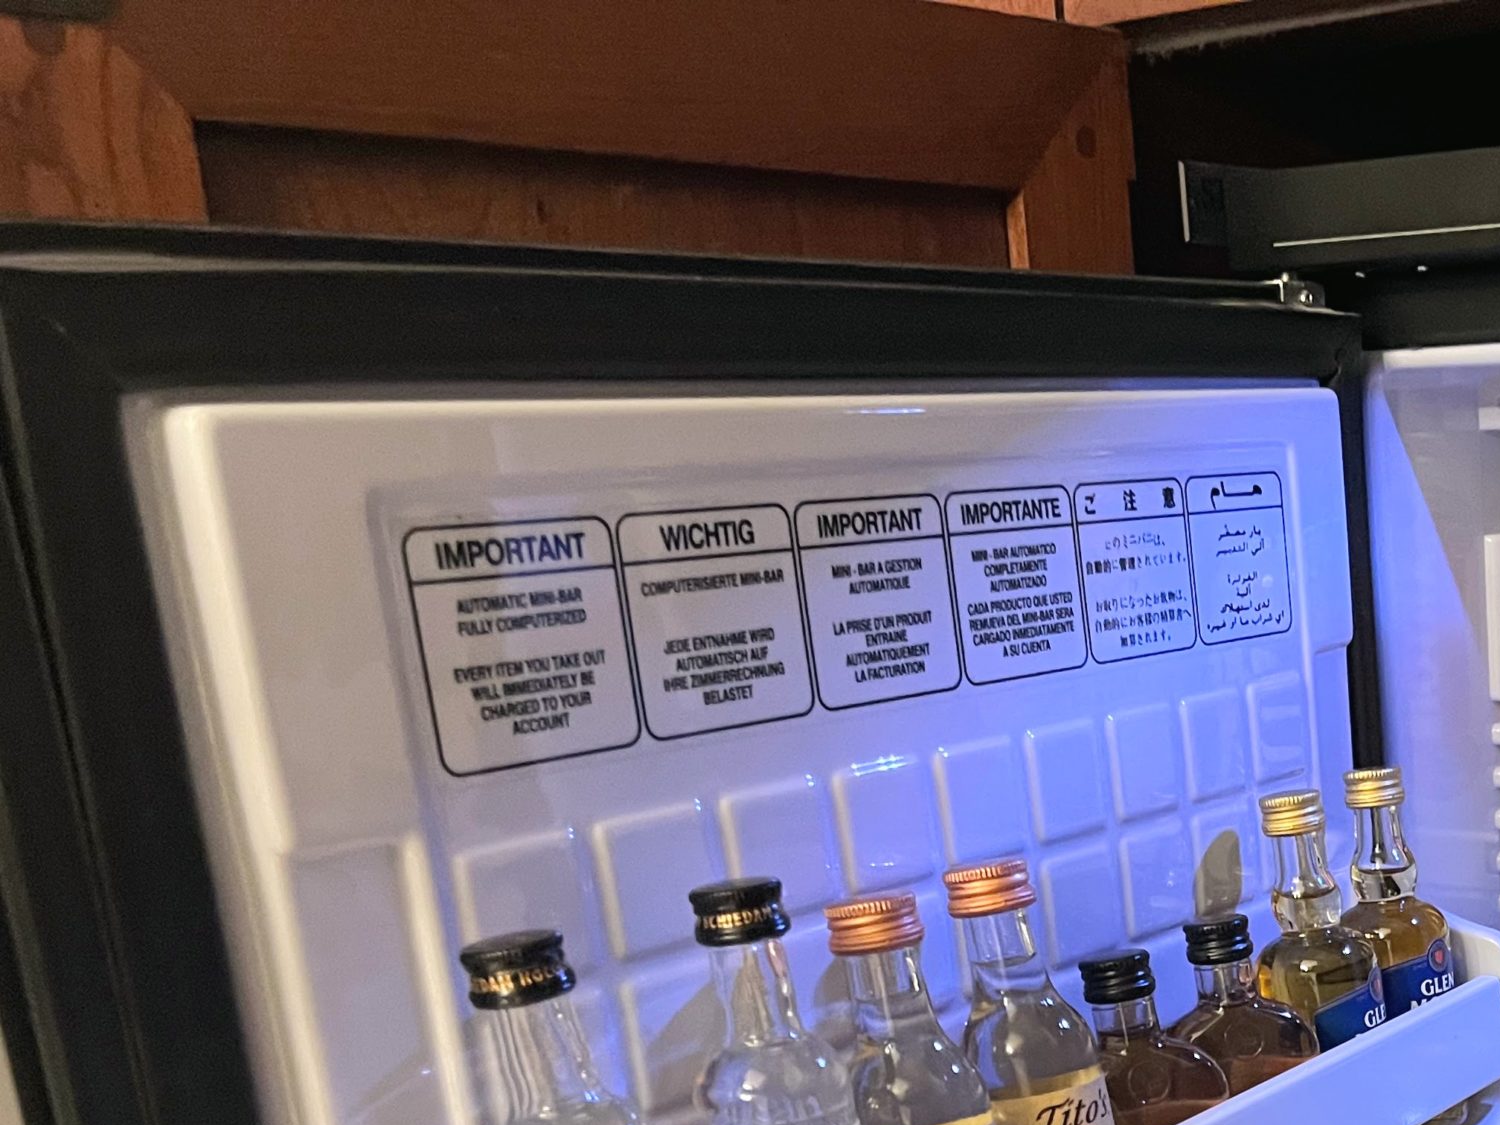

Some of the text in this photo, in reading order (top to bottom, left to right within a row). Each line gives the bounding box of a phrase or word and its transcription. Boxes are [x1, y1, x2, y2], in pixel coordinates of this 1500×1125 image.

[816, 507, 922, 539] IMPORTANT
[960, 498, 1062, 526] IMPORTANTE
[659, 519, 756, 552] WICHTIG
[434, 533, 586, 570] IMPORTANT
[1010, 542, 1057, 558] AUTOMATICO
[885, 557, 923, 574] GESTION
[983, 558, 1048, 578] COMPLETAMENTE
[640, 568, 785, 597] COMPUTERISIERTE MINI-BAR
[849, 576, 911, 595] AUTOMATIQUE
[990, 574, 1047, 593] AUTOMATIZADO
[457, 587, 583, 614] AUTOMATIC MINI-BAR
[967, 591, 1073, 617] CADA PRODUCTO QUE USTED
[457, 608, 587, 637] FULLY COMPUTERIZED
[832, 610, 932, 636] LA PRISE D'UN PRODUIT
[969, 617, 1006, 632] REMUEVA
[1006, 613, 1022, 627] DEL
[972, 620, 1075, 647] CARGADO INMEDIATAMENTE
[663, 627, 775, 655] JEDE ENTNAHME WIRD
[1009, 644, 1020, 658] SU
[1021, 639, 1052, 655] CUENTA
[453, 649, 606, 684] EVERY ITEM YOU TAKE OUT
[676, 646, 769, 672] AUTOMATISCH AUF
[846, 642, 930, 667] AUTOMATIQUEMENT
[663, 661, 786, 692] IHRE ZIMMERRECHNUNG
[854, 660, 926, 683] LA FACTURATION
[471, 670, 596, 702] WILL IMMEDIATELY BE
[702, 684, 754, 705] BELASTET
[480, 691, 593, 721] CHARGED TO YOUR
[513, 712, 571, 735] ACCOUNT
[1420, 972, 1455, 996] GLEN
